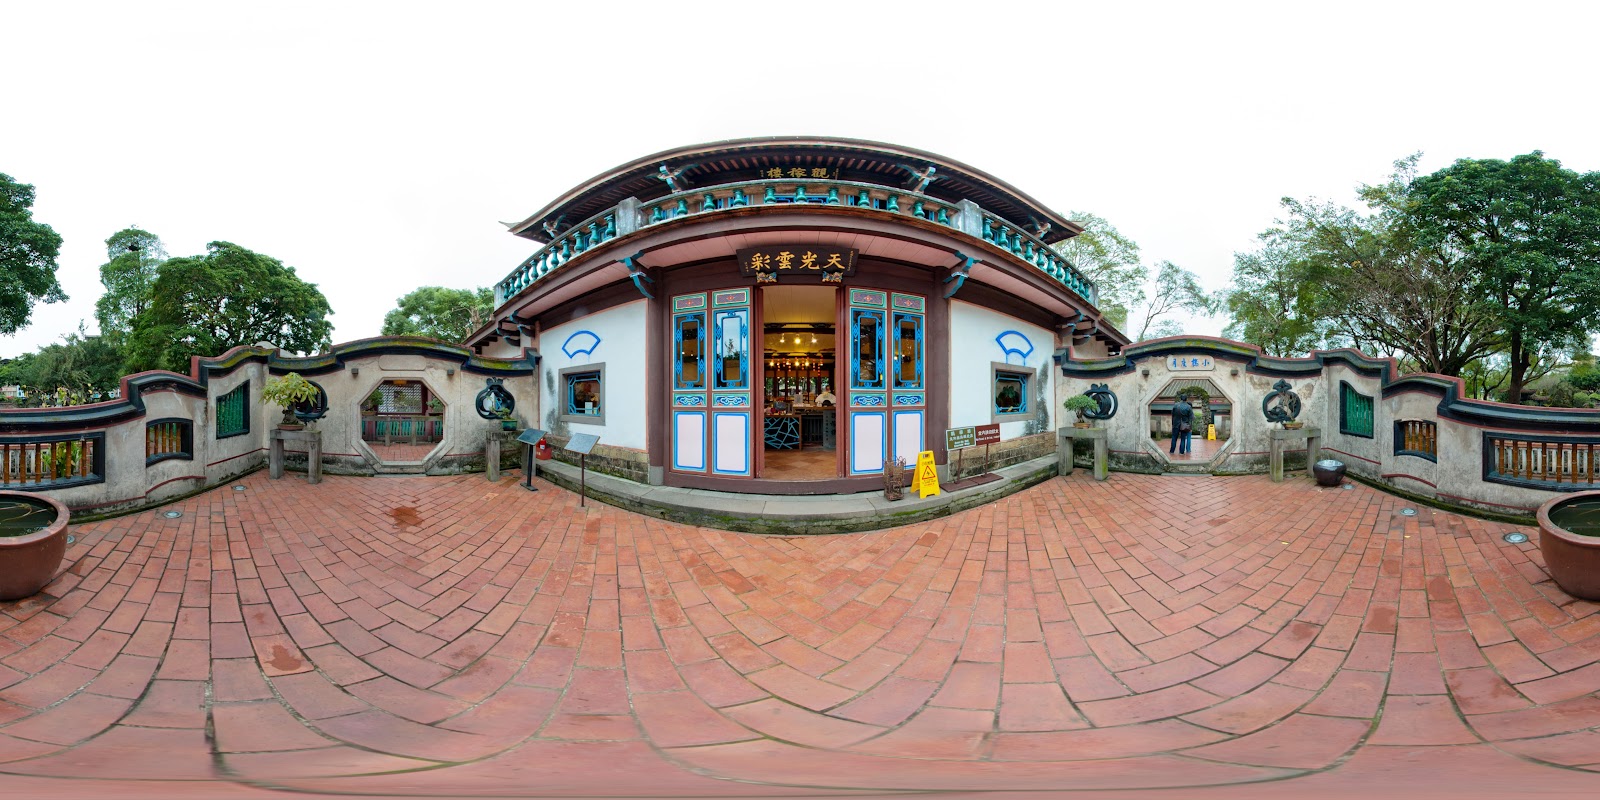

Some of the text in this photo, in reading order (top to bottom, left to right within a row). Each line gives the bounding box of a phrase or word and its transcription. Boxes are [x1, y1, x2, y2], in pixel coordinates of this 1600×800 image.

[767, 167, 830, 178] 觀稼樓
[751, 251, 846, 270] 天光雲彩
